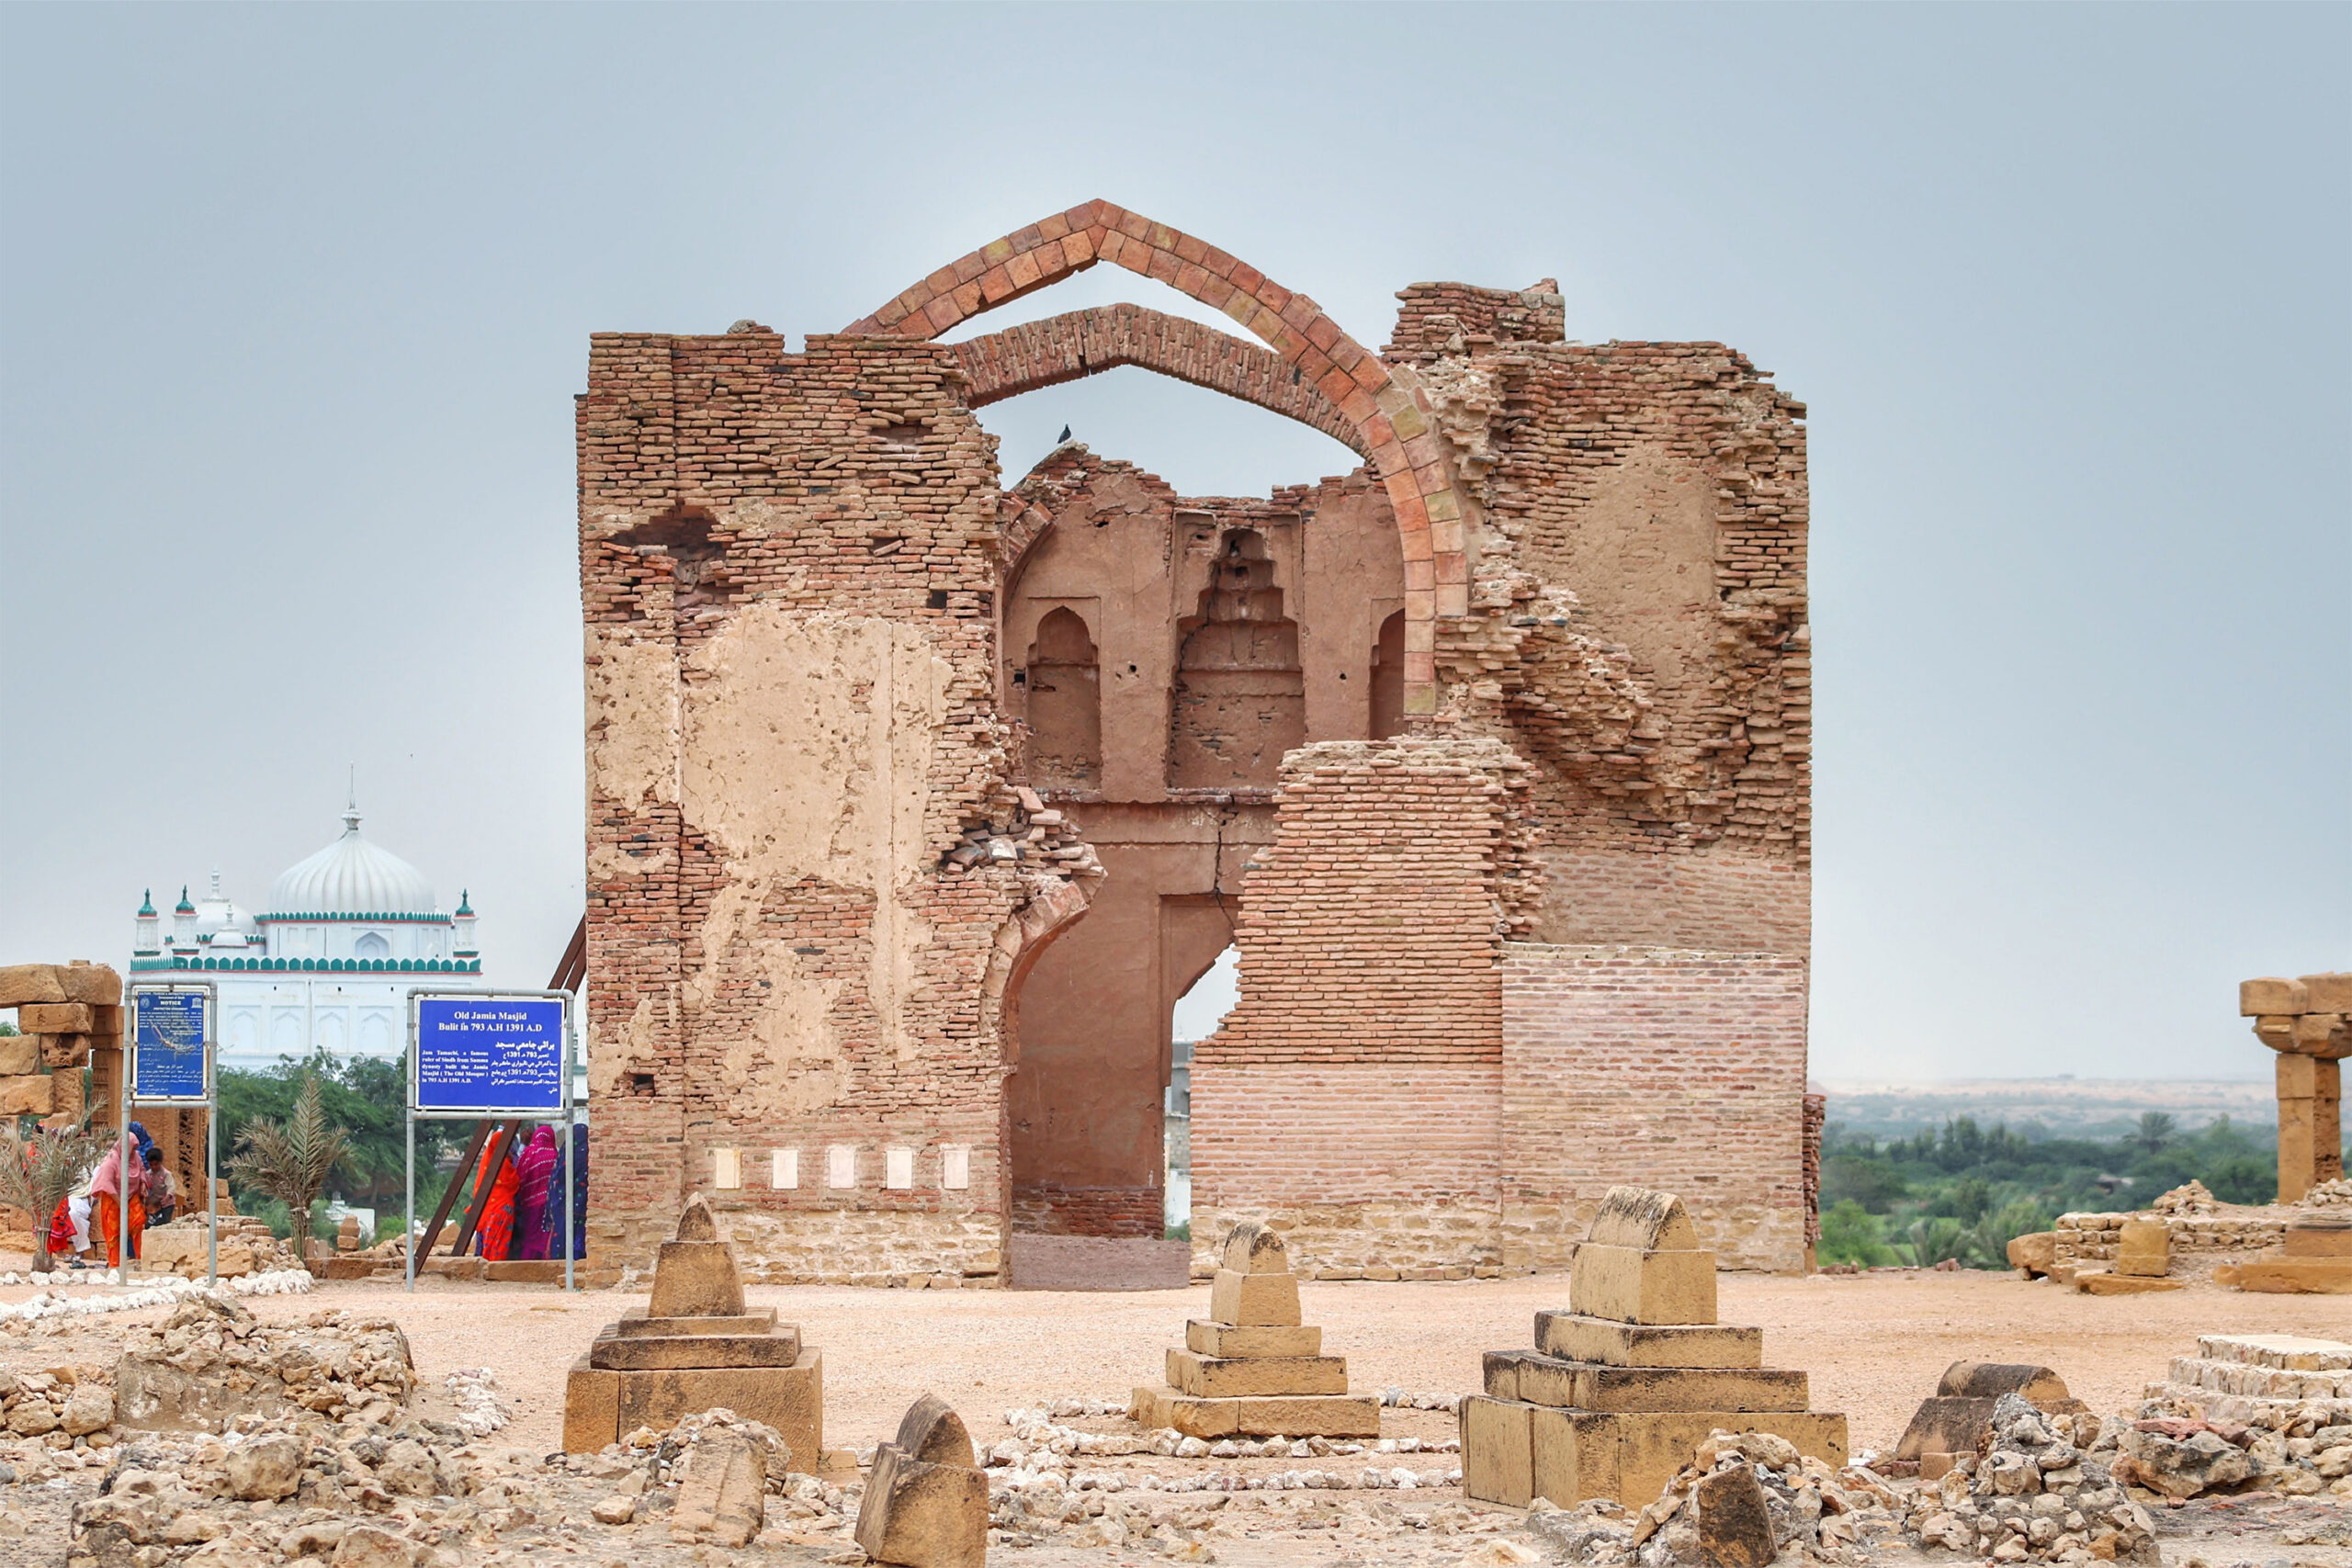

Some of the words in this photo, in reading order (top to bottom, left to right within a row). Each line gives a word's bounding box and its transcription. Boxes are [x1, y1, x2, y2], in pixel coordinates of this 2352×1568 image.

[498, 1012, 527, 1022] Masjid
[439, 1023, 458, 1031] Bulit
[460, 1022, 468, 1031] in
